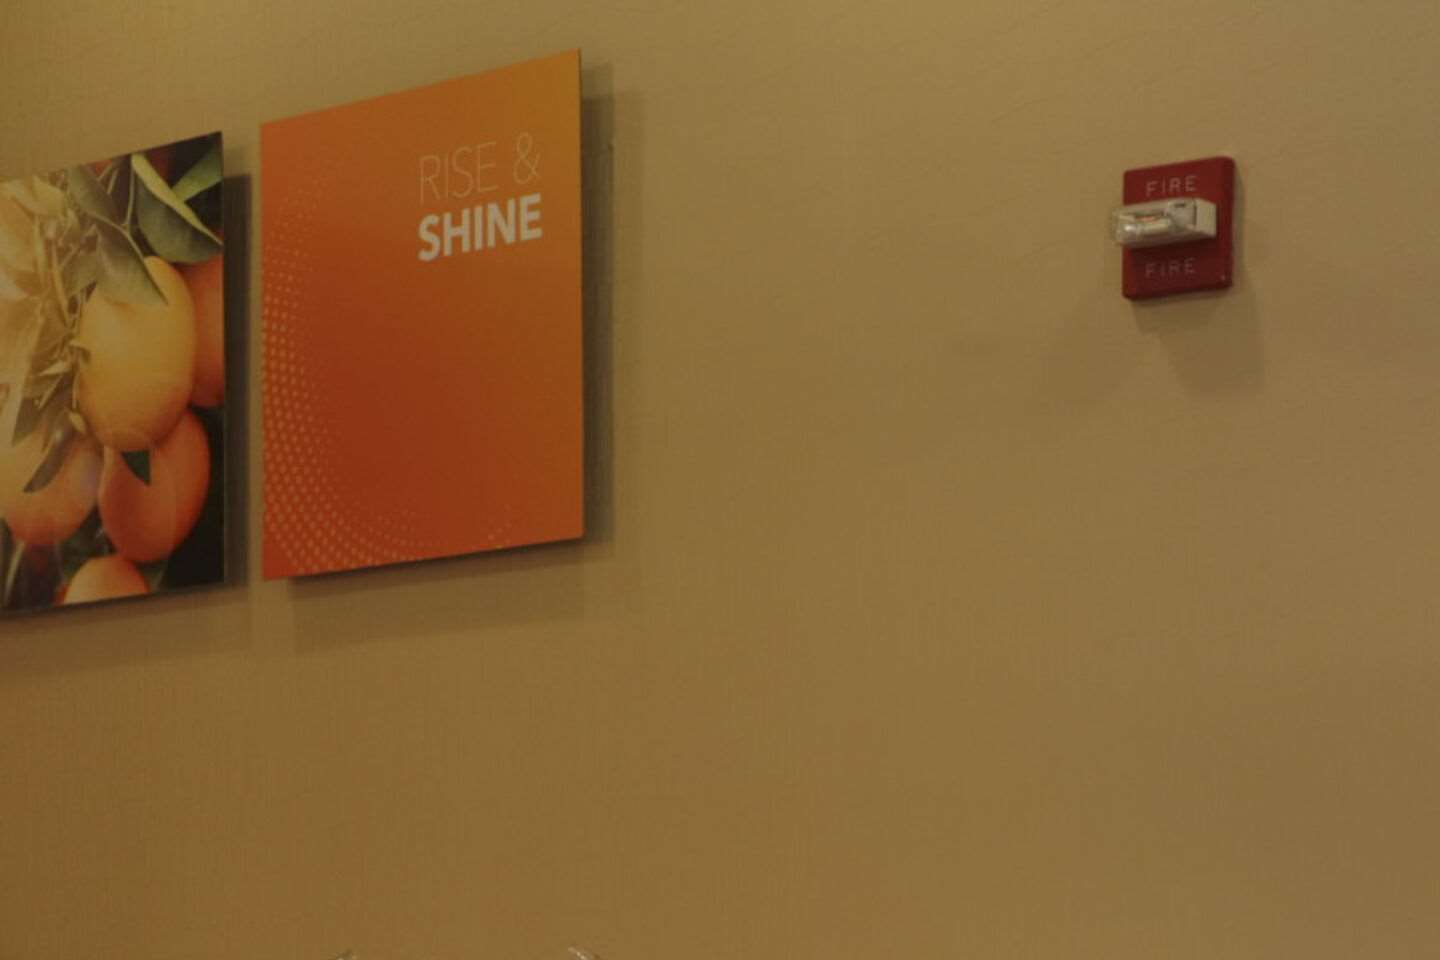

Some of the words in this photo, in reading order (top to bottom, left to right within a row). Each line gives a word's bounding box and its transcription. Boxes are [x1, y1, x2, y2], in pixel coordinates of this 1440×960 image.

[418, 140, 500, 206] RISE
[513, 131, 542, 186] &
[1146, 174, 1198, 197] FIRE
[417, 192, 543, 263] SHINE
[1145, 257, 1196, 279] FIRE
